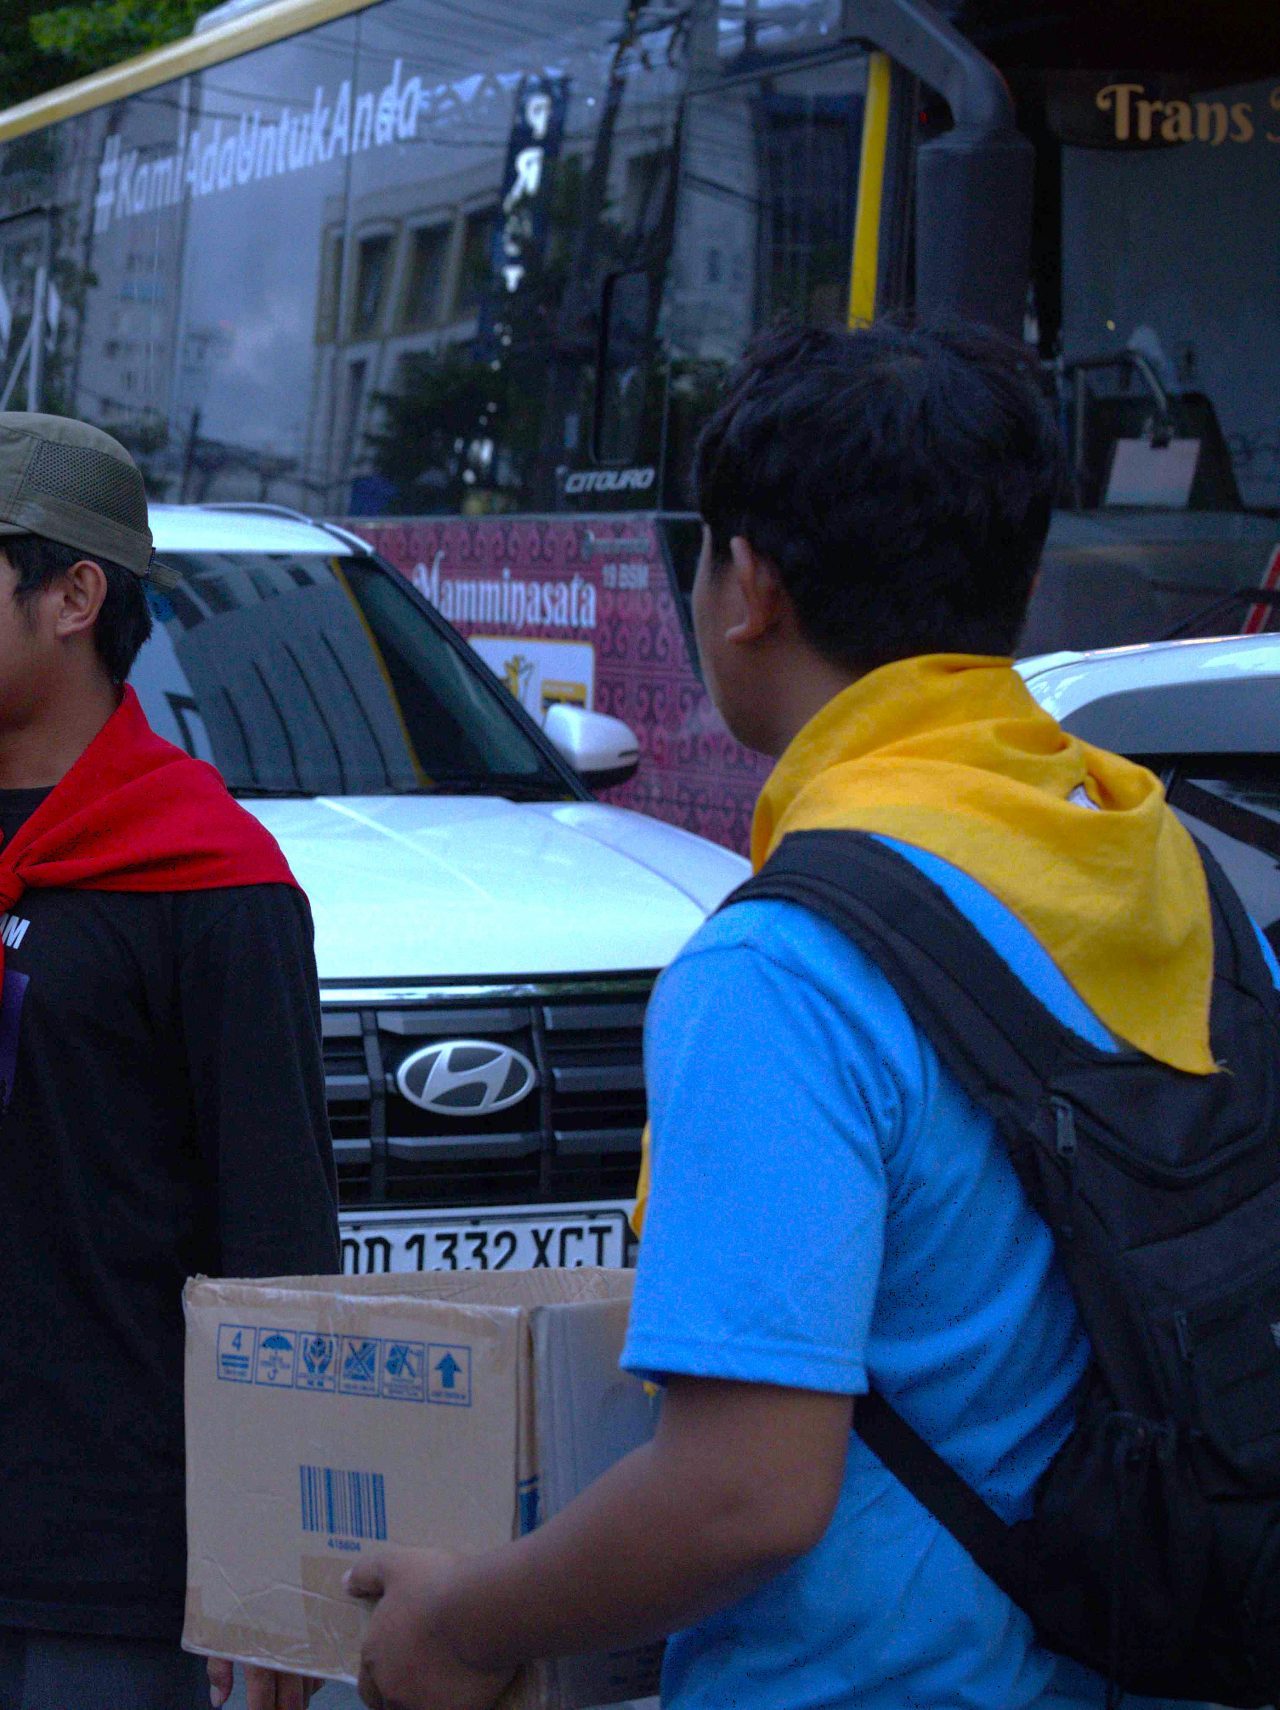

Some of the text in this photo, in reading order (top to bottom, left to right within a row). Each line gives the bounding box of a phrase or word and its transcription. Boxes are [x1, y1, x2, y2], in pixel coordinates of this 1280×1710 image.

[1095, 82, 1254, 146] Trans
[405, 1230, 518, 1271] 1332
[532, 1226, 612, 1269] XCT
[231, 1330, 243, 1351] 4
